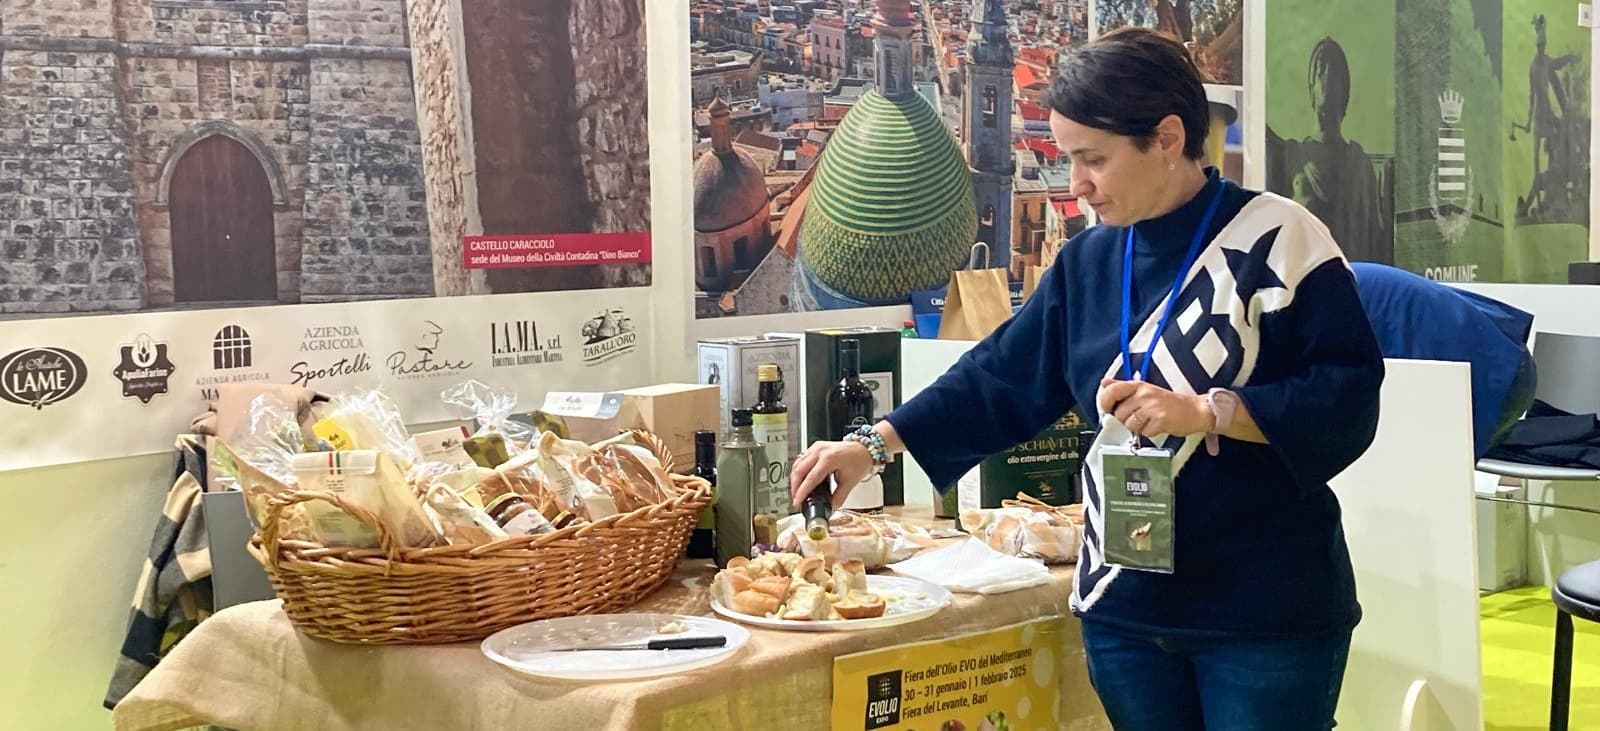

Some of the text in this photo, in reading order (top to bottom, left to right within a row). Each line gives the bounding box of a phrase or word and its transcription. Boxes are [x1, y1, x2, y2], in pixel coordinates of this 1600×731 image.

[471, 239, 555, 250] CASTELLO CARACCIOLO
[471, 254, 488, 264] sede
[490, 253, 500, 263] del
[502, 253, 525, 263] Museo
[527, 252, 543, 262] della
[544, 251, 565, 261] Civiltà
[566, 250, 599, 260] Contadina
[304, 325, 360, 338] AZIENDA
[300, 338, 363, 351] AGRICOLA
[291, 353, 371, 387] Sportelli
[386, 351, 473, 375] Pastore
[13, 369, 67, 394] LAME
[196, 376, 229, 385] AZIENDA
[1007, 456, 1019, 464] olio
[904, 648, 1032, 683] Fiera dell'Olio EVO del Mediterraneo
[904, 689, 915, 701] 30
[924, 684, 934, 697] 31
[935, 678, 967, 697] gennaio
[981, 671, 1008, 686] febbraio
[1009, 664, 1027, 680] 2025
[869, 697, 898, 719] EVOLIO
[903, 690, 987, 720] Fiera del Levante, Bari
